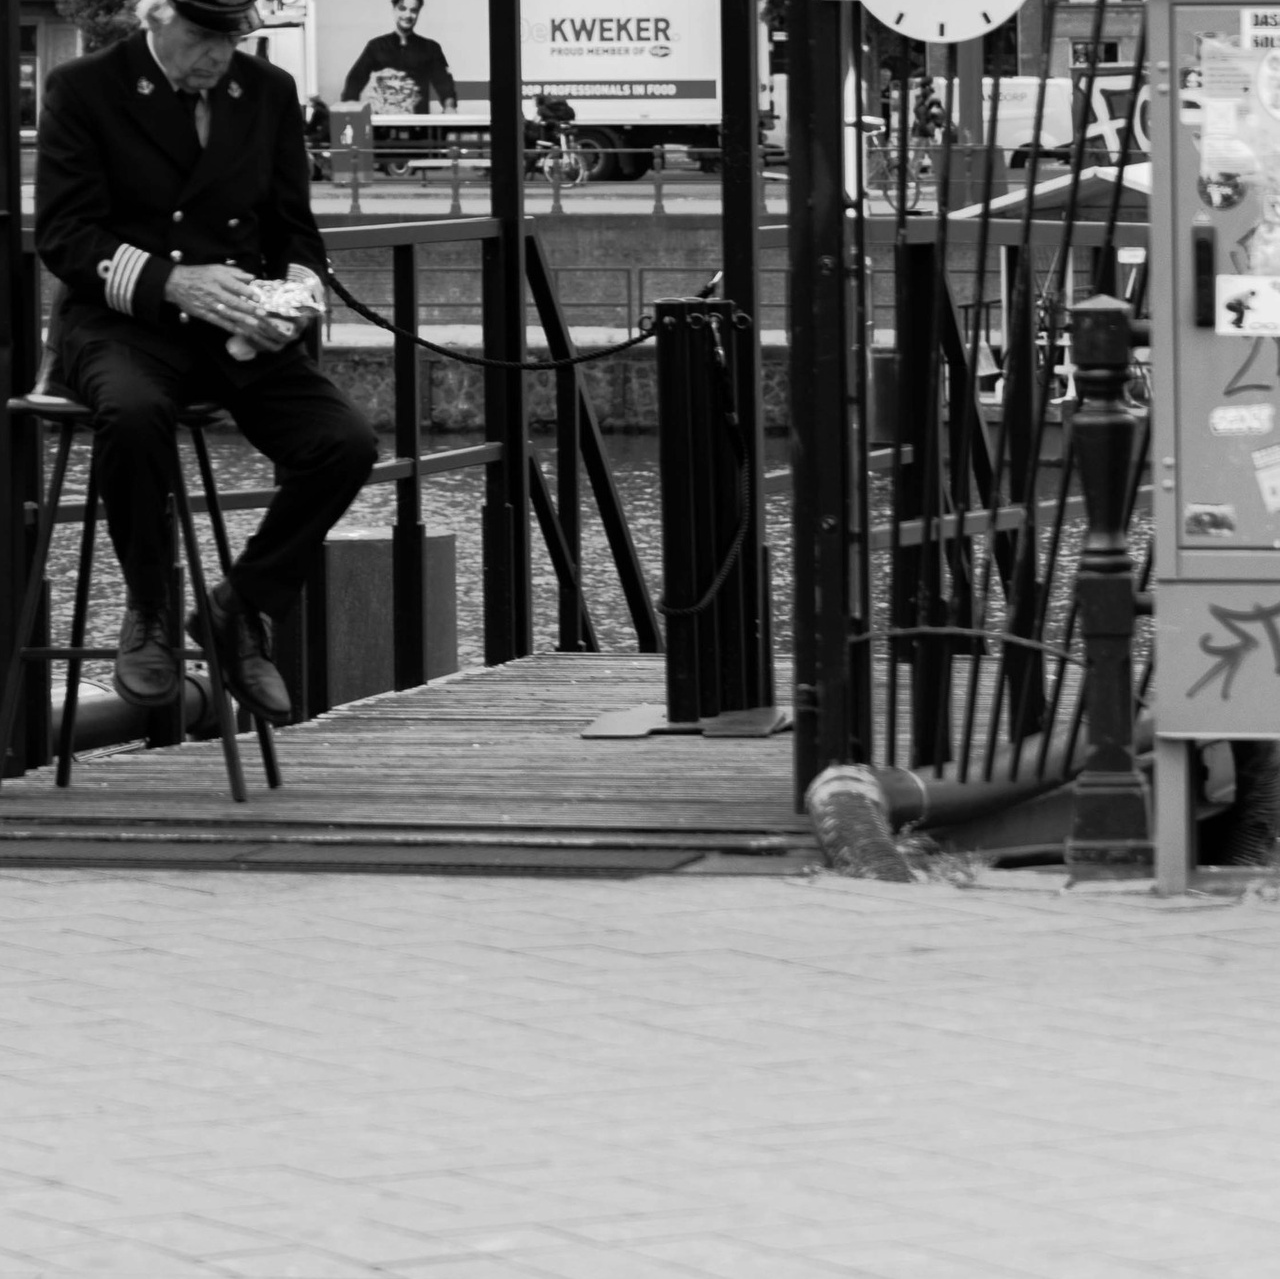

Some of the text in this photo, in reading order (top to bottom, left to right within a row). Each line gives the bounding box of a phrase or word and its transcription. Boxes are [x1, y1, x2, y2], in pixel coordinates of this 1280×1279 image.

[551, 18, 671, 42] KWEKER
[543, 83, 631, 97] PROFESSIONALS
[632, 83, 646, 96] IN
[646, 82, 677, 96] FOOD
